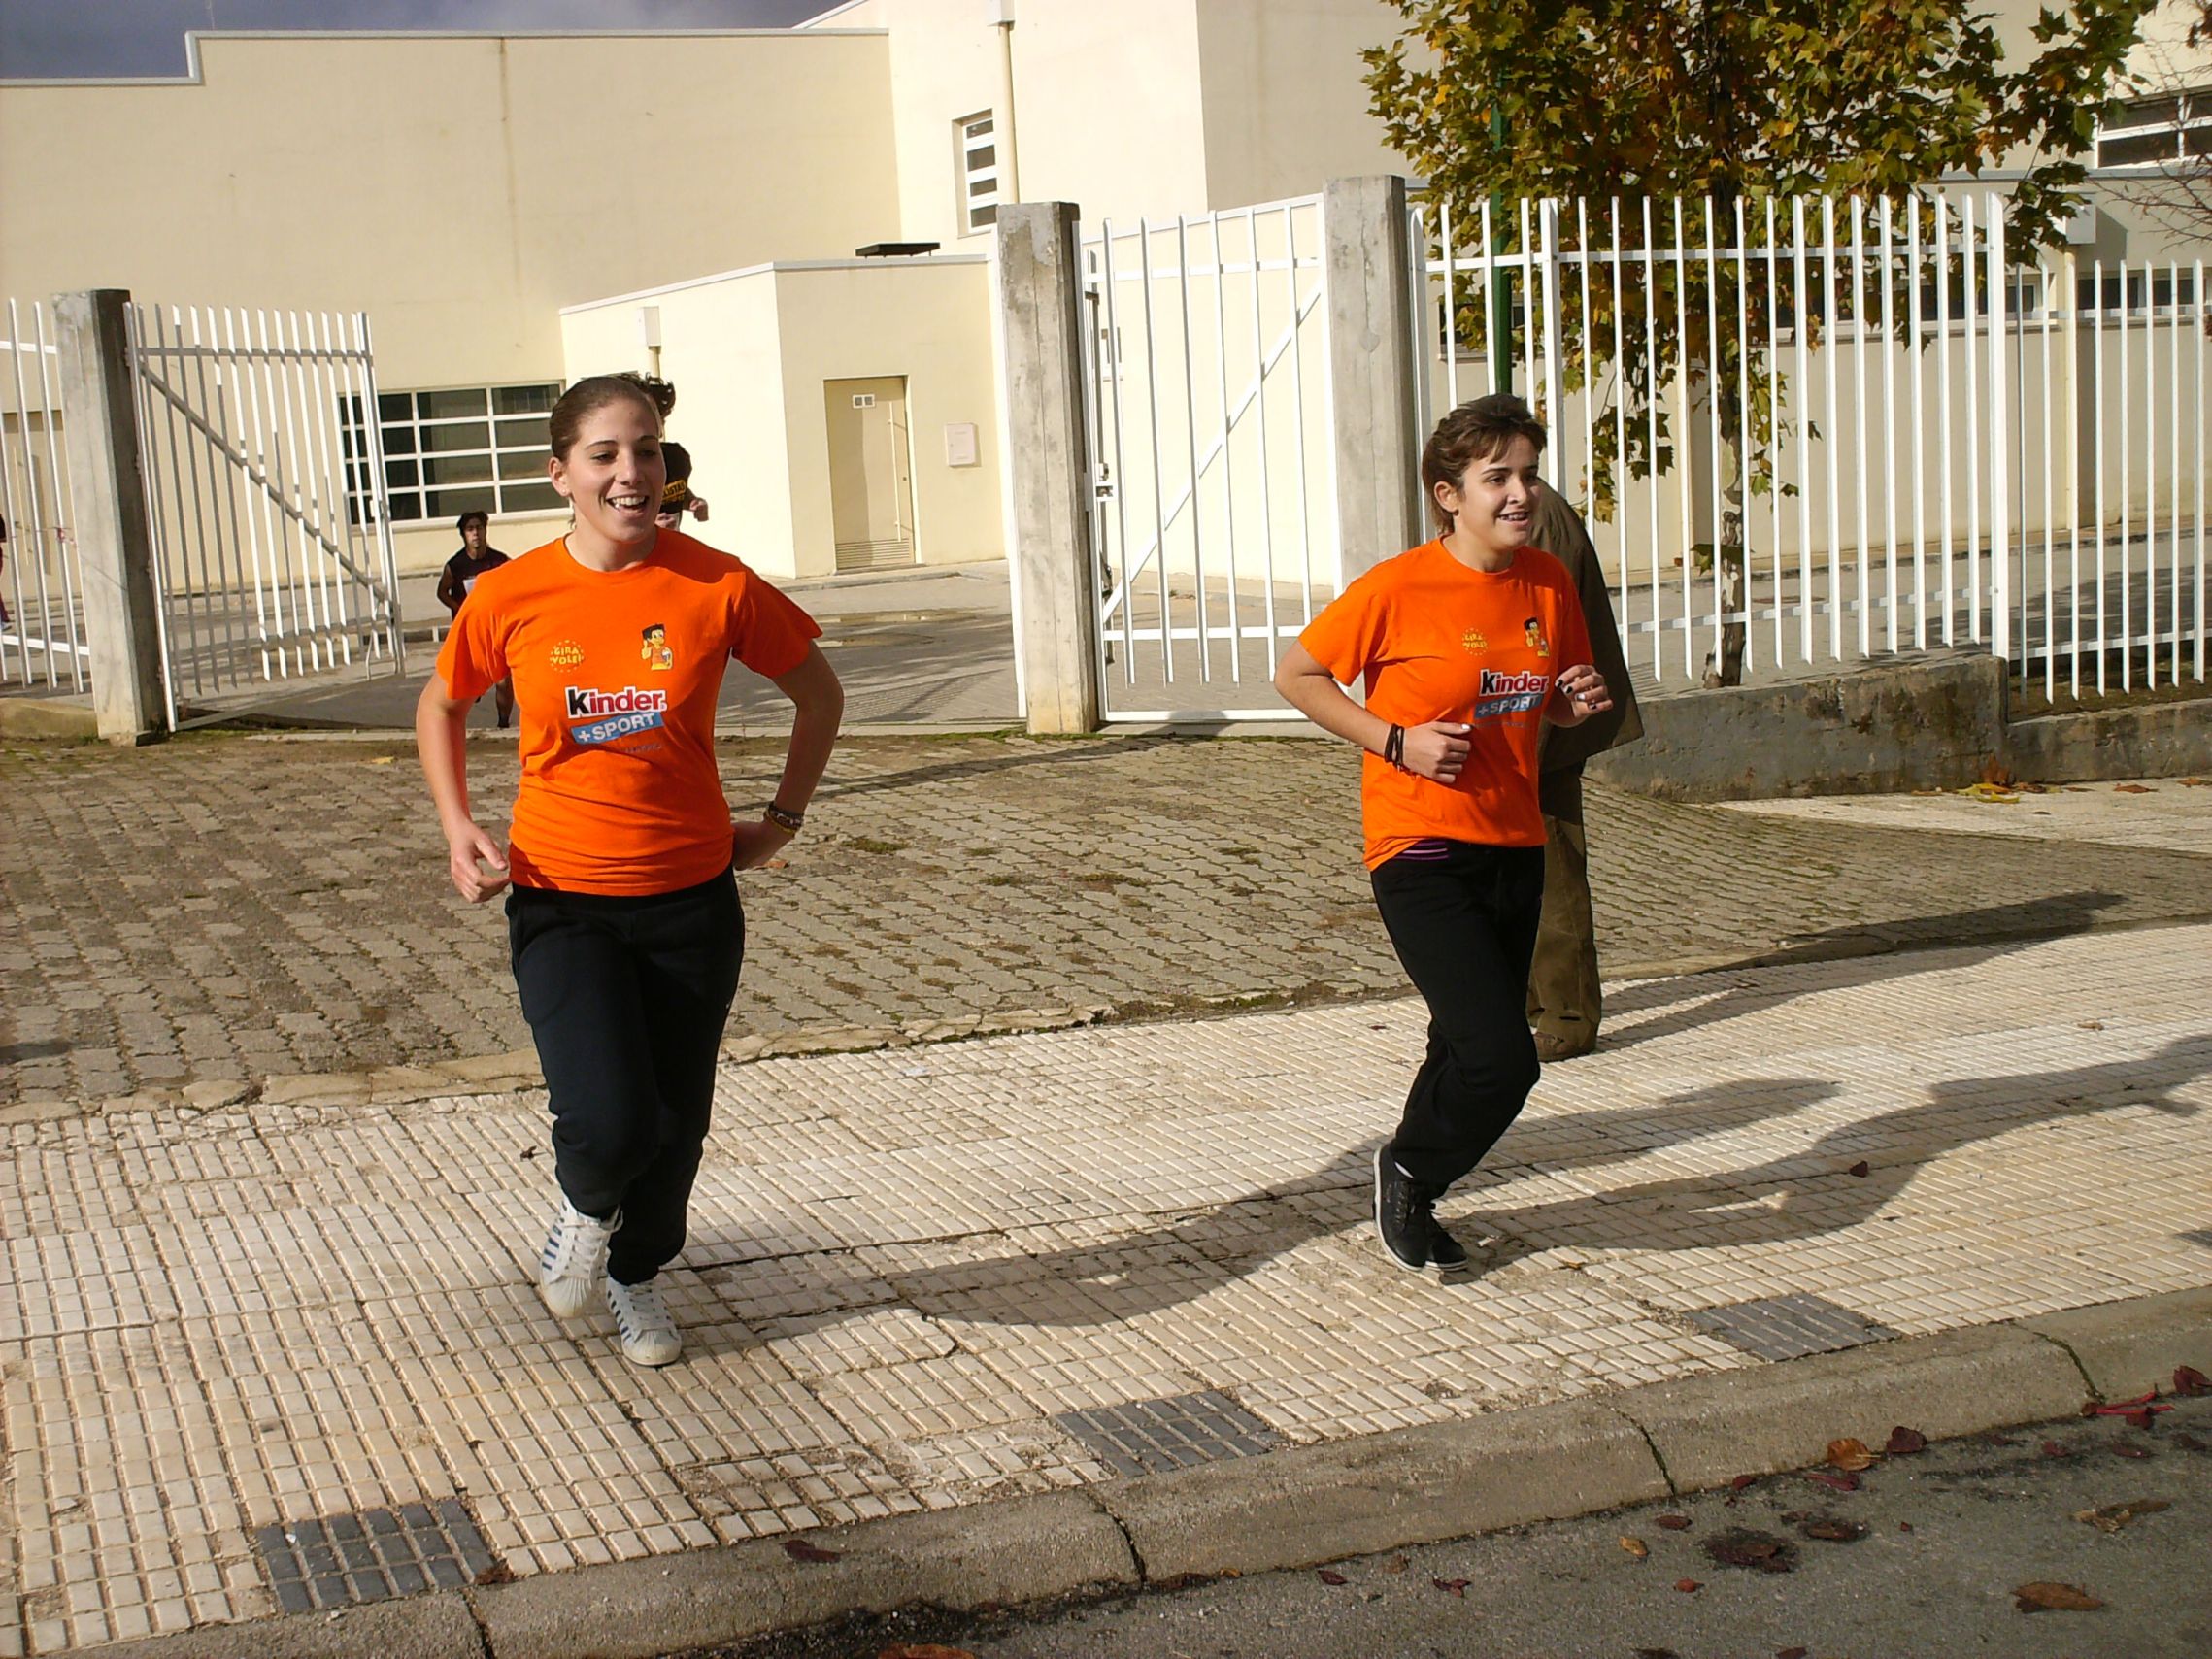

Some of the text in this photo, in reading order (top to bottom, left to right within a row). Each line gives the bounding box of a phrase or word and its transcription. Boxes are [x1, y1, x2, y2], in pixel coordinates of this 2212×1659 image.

[553, 647, 579, 656] GIRA
[1481, 671, 1549, 694] Kinder
[567, 688, 664, 716] Kinder
